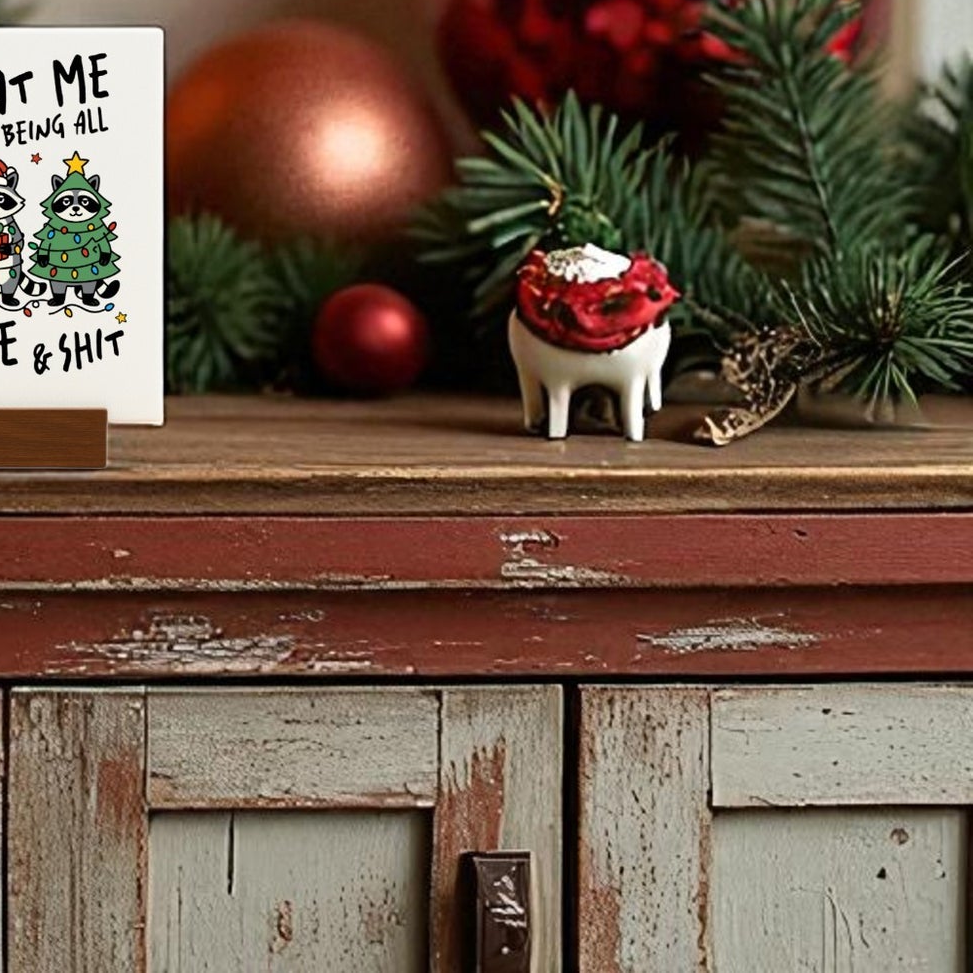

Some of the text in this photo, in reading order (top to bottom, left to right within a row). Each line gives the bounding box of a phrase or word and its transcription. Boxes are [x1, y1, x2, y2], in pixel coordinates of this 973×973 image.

[52, 53, 110, 108] ME
[0, 106, 110, 148] BEING ALL
[33, 343, 53, 377] &
[58, 328, 125, 373] SHIT
